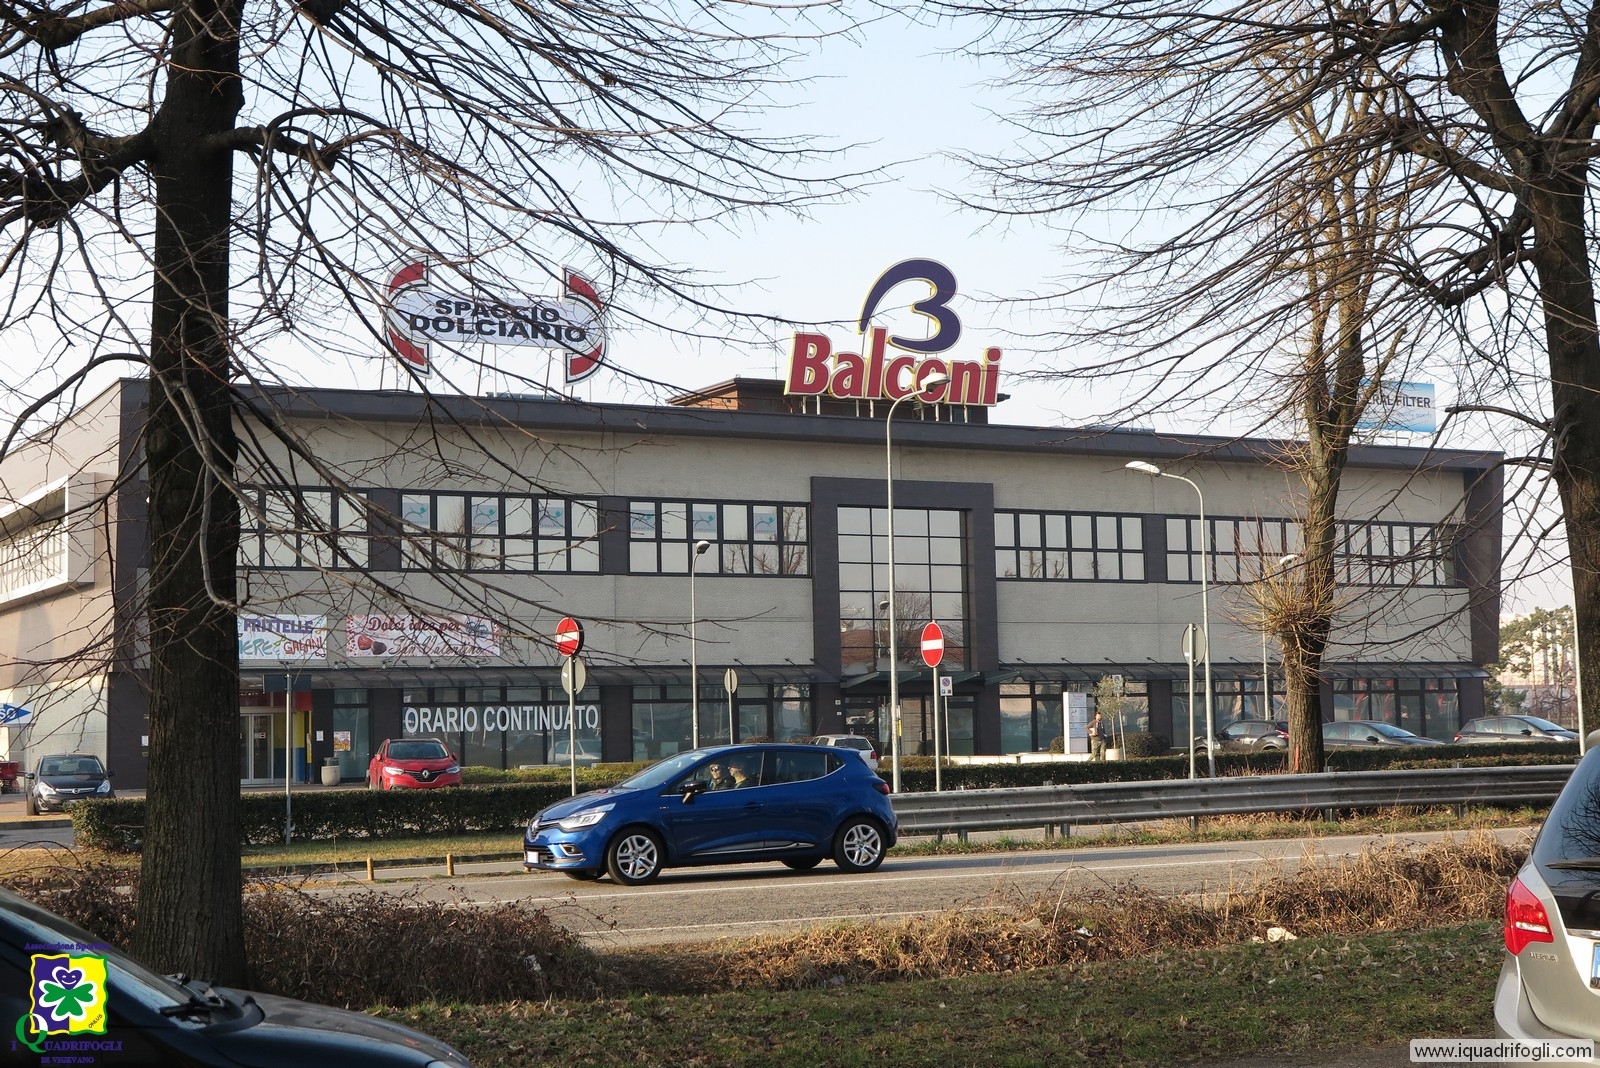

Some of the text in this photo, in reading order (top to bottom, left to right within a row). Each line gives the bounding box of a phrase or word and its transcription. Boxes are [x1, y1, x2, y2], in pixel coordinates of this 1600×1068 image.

[435, 299, 560, 323] SPACCIO
[408, 314, 587, 343] DOLCIARIO
[784, 326, 1003, 407] Balconi
[243, 618, 314, 633] FRITTELLE
[405, 705, 599, 733] ORARIO CONTINUATO
